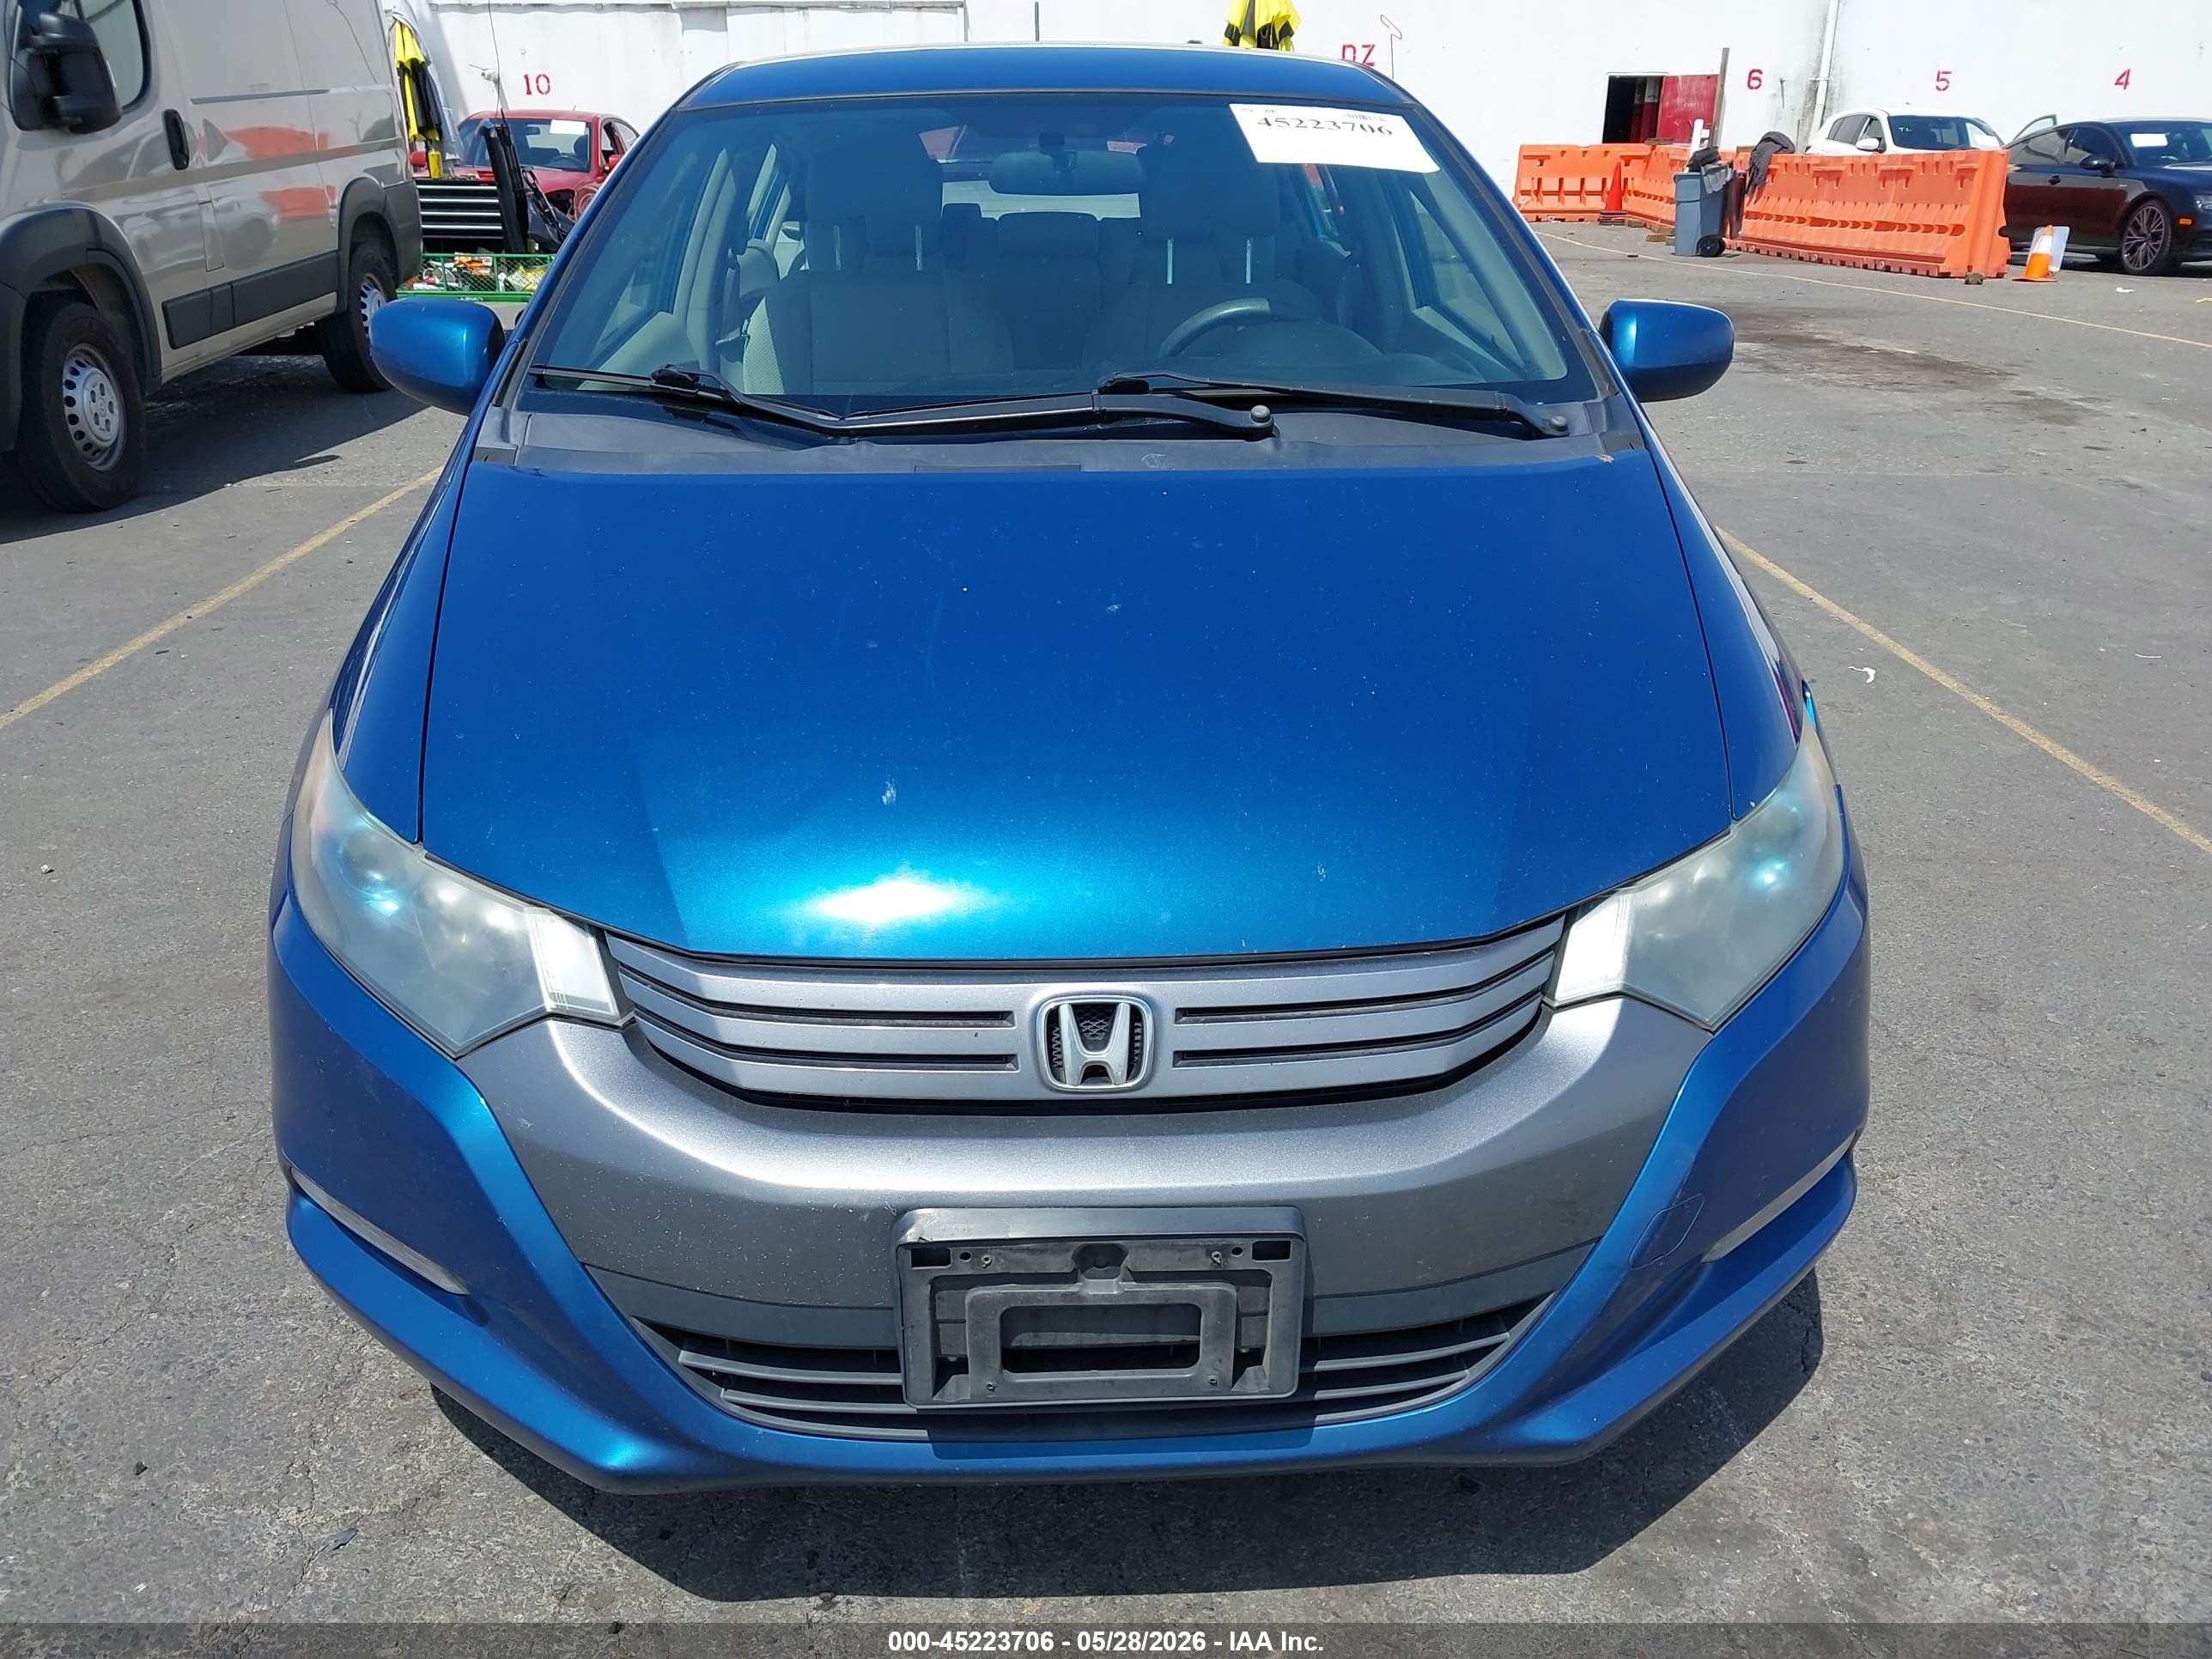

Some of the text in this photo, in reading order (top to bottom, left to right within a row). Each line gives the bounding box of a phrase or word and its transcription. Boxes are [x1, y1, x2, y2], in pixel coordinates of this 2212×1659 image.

[523, 74, 551, 95] 10
[1747, 69, 1763, 90] 6
[1936, 70, 1952, 91] 5
[2114, 69, 2130, 90] 4
[1257, 117, 1394, 136] 45223706
